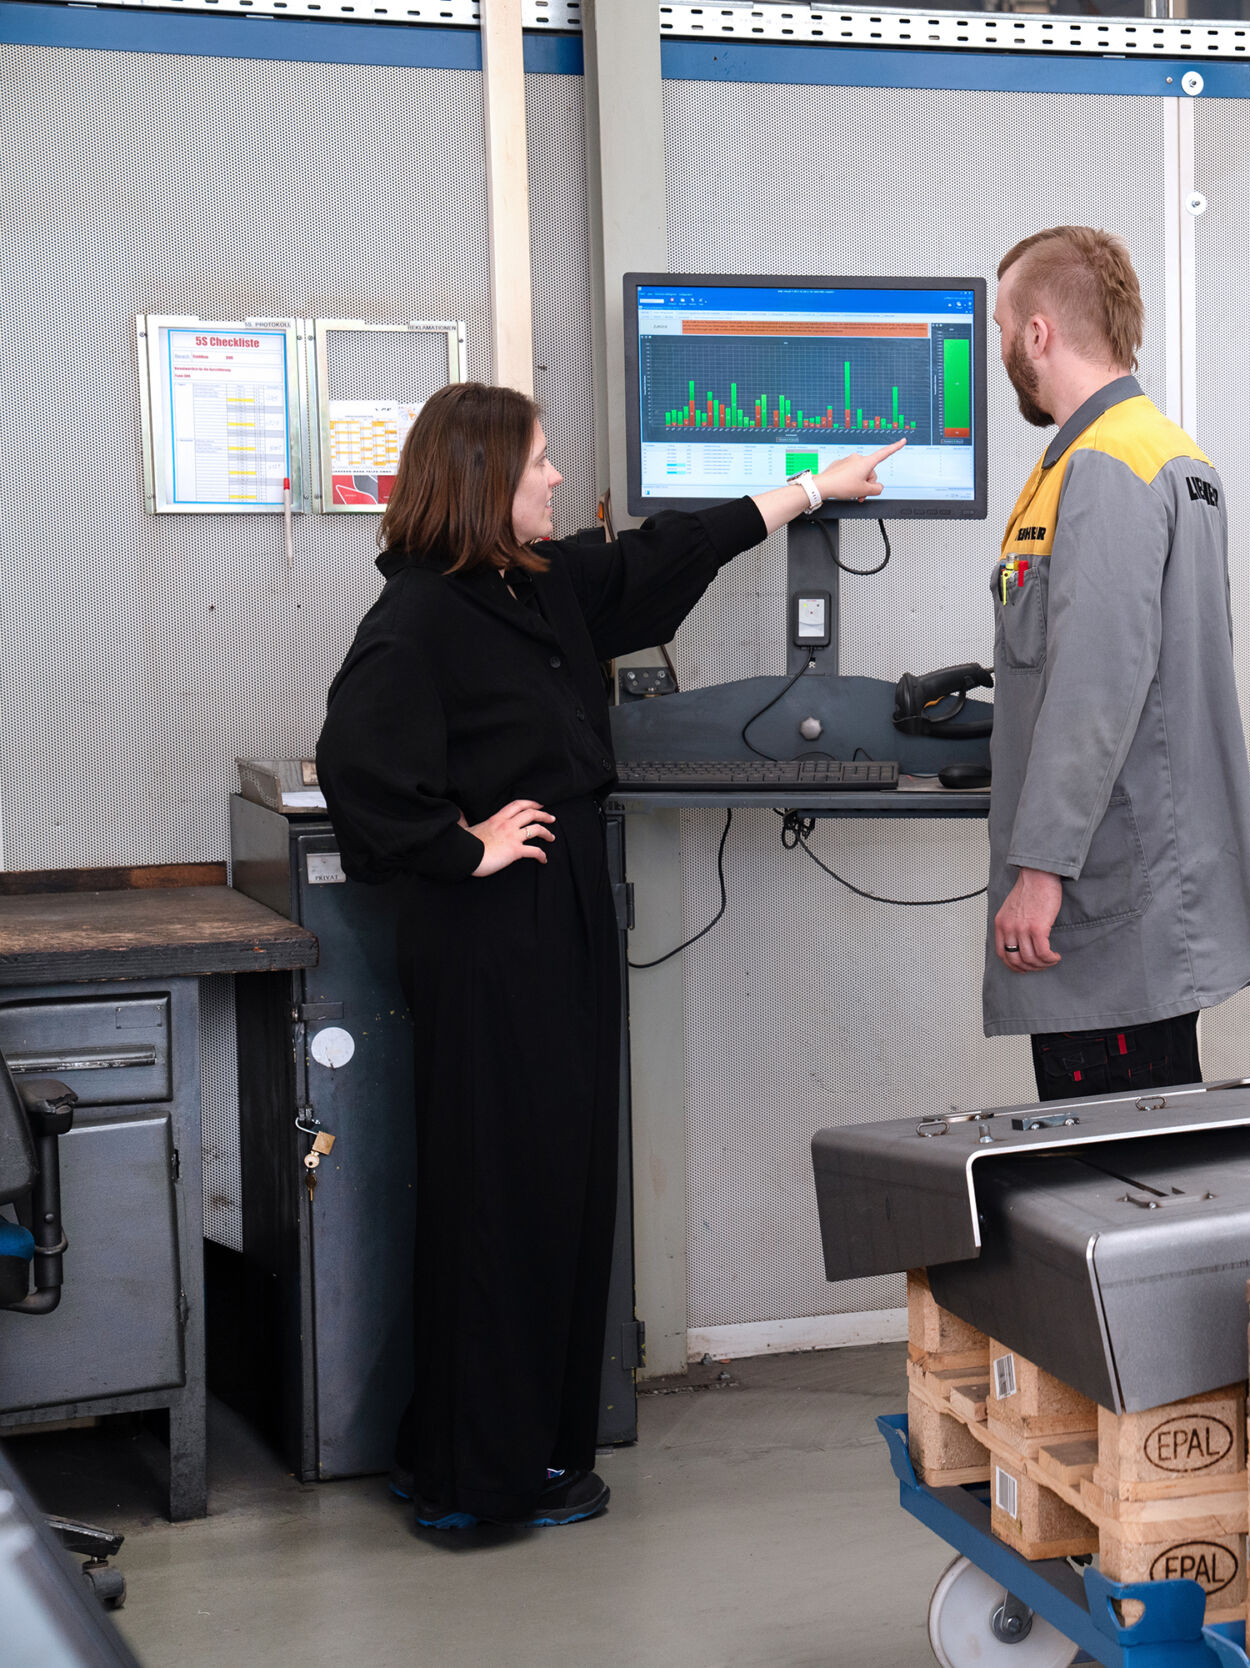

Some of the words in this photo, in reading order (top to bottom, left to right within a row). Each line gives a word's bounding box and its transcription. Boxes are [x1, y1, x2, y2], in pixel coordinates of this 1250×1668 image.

[195, 336, 208, 346] 5S
[209, 337, 260, 348] Checkliste
[1157, 1427, 1221, 1461] EPAL
